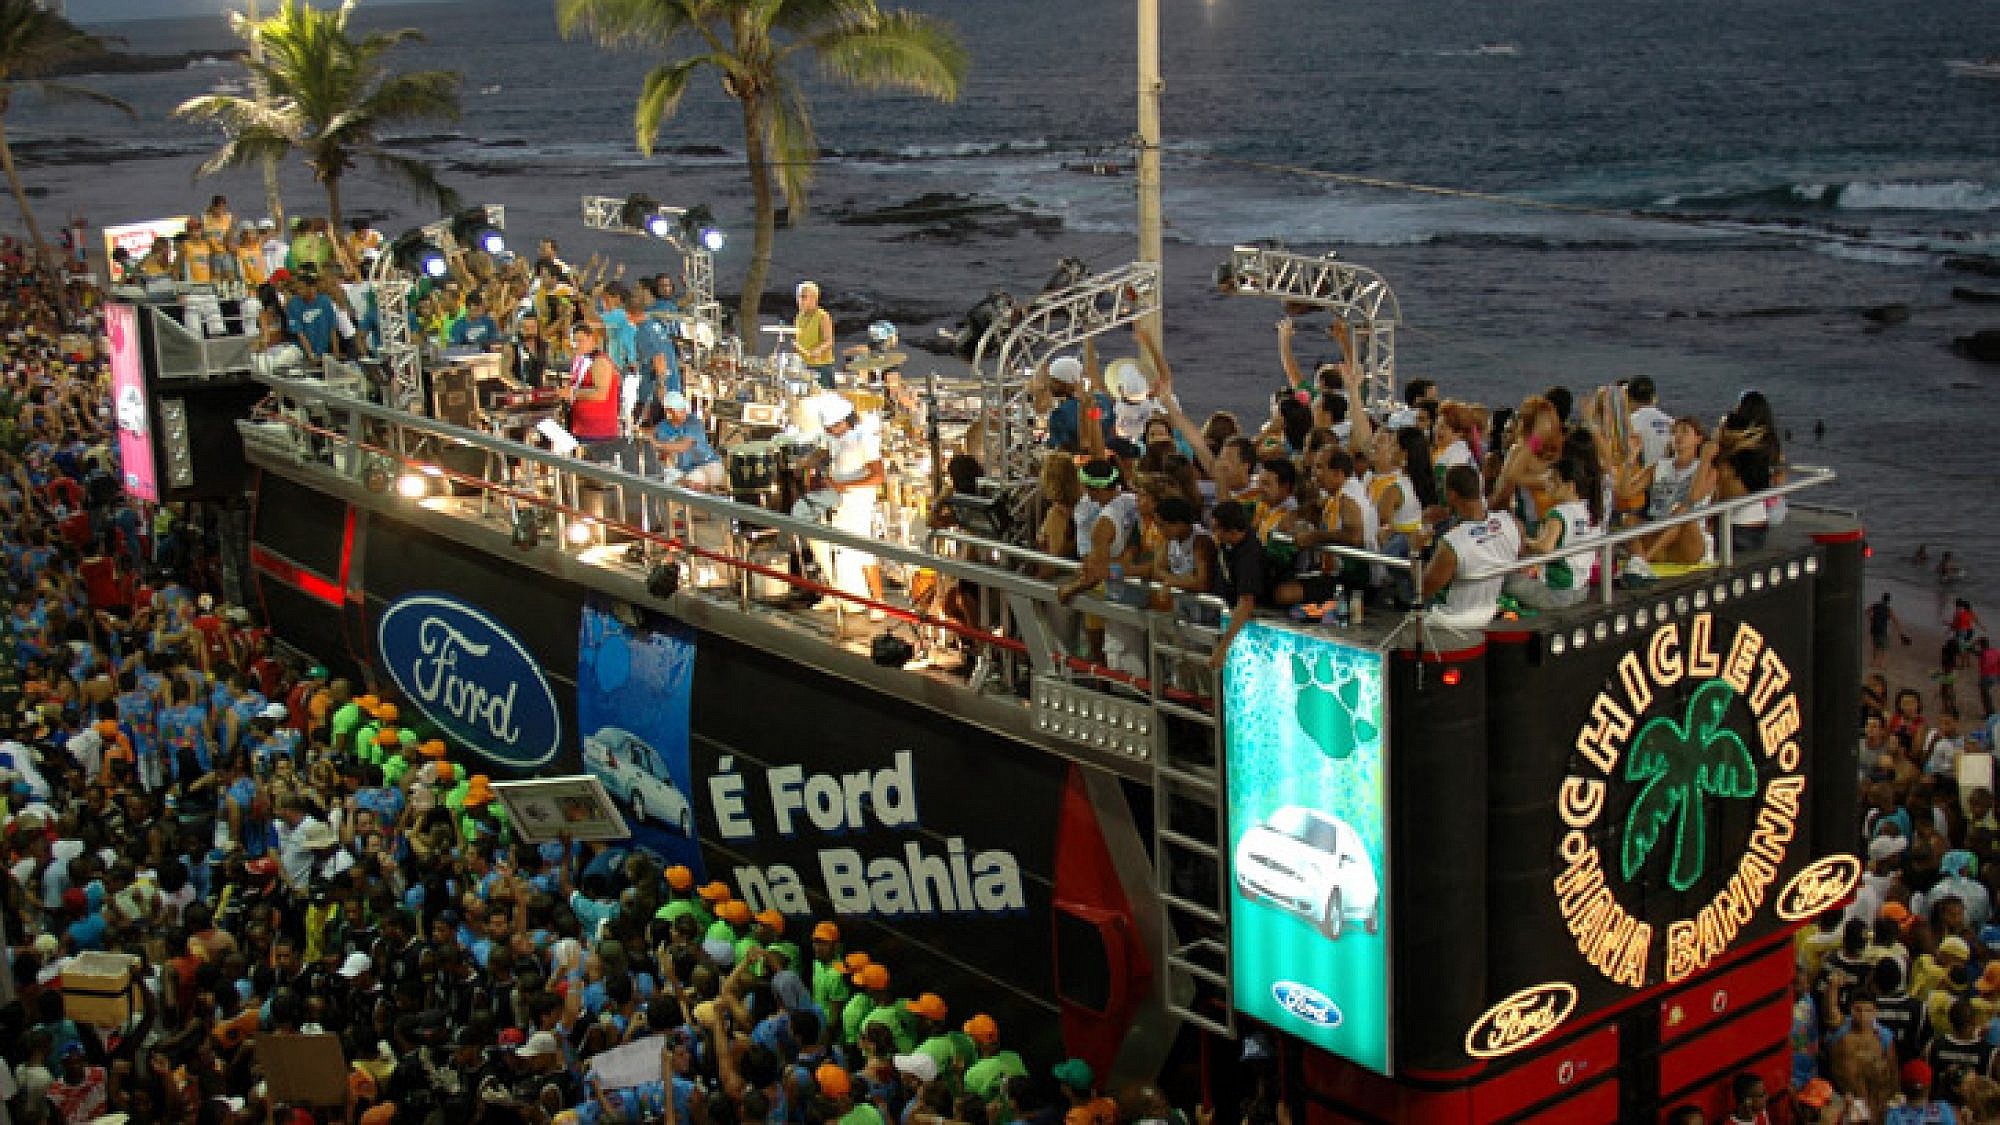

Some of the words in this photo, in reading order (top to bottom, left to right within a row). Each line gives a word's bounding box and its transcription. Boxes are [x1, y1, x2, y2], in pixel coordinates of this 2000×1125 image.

[413, 616, 521, 745] Ford
[1559, 612, 1802, 827] CHICLETE
[708, 755, 754, 838] É
[767, 750, 918, 834] Ford
[733, 863, 811, 915] na
[818, 837, 1026, 914] Bahia
[1667, 775, 1806, 983] BANANA
[1793, 864, 1846, 911] Ford
[1487, 992, 1557, 1049] Ford
